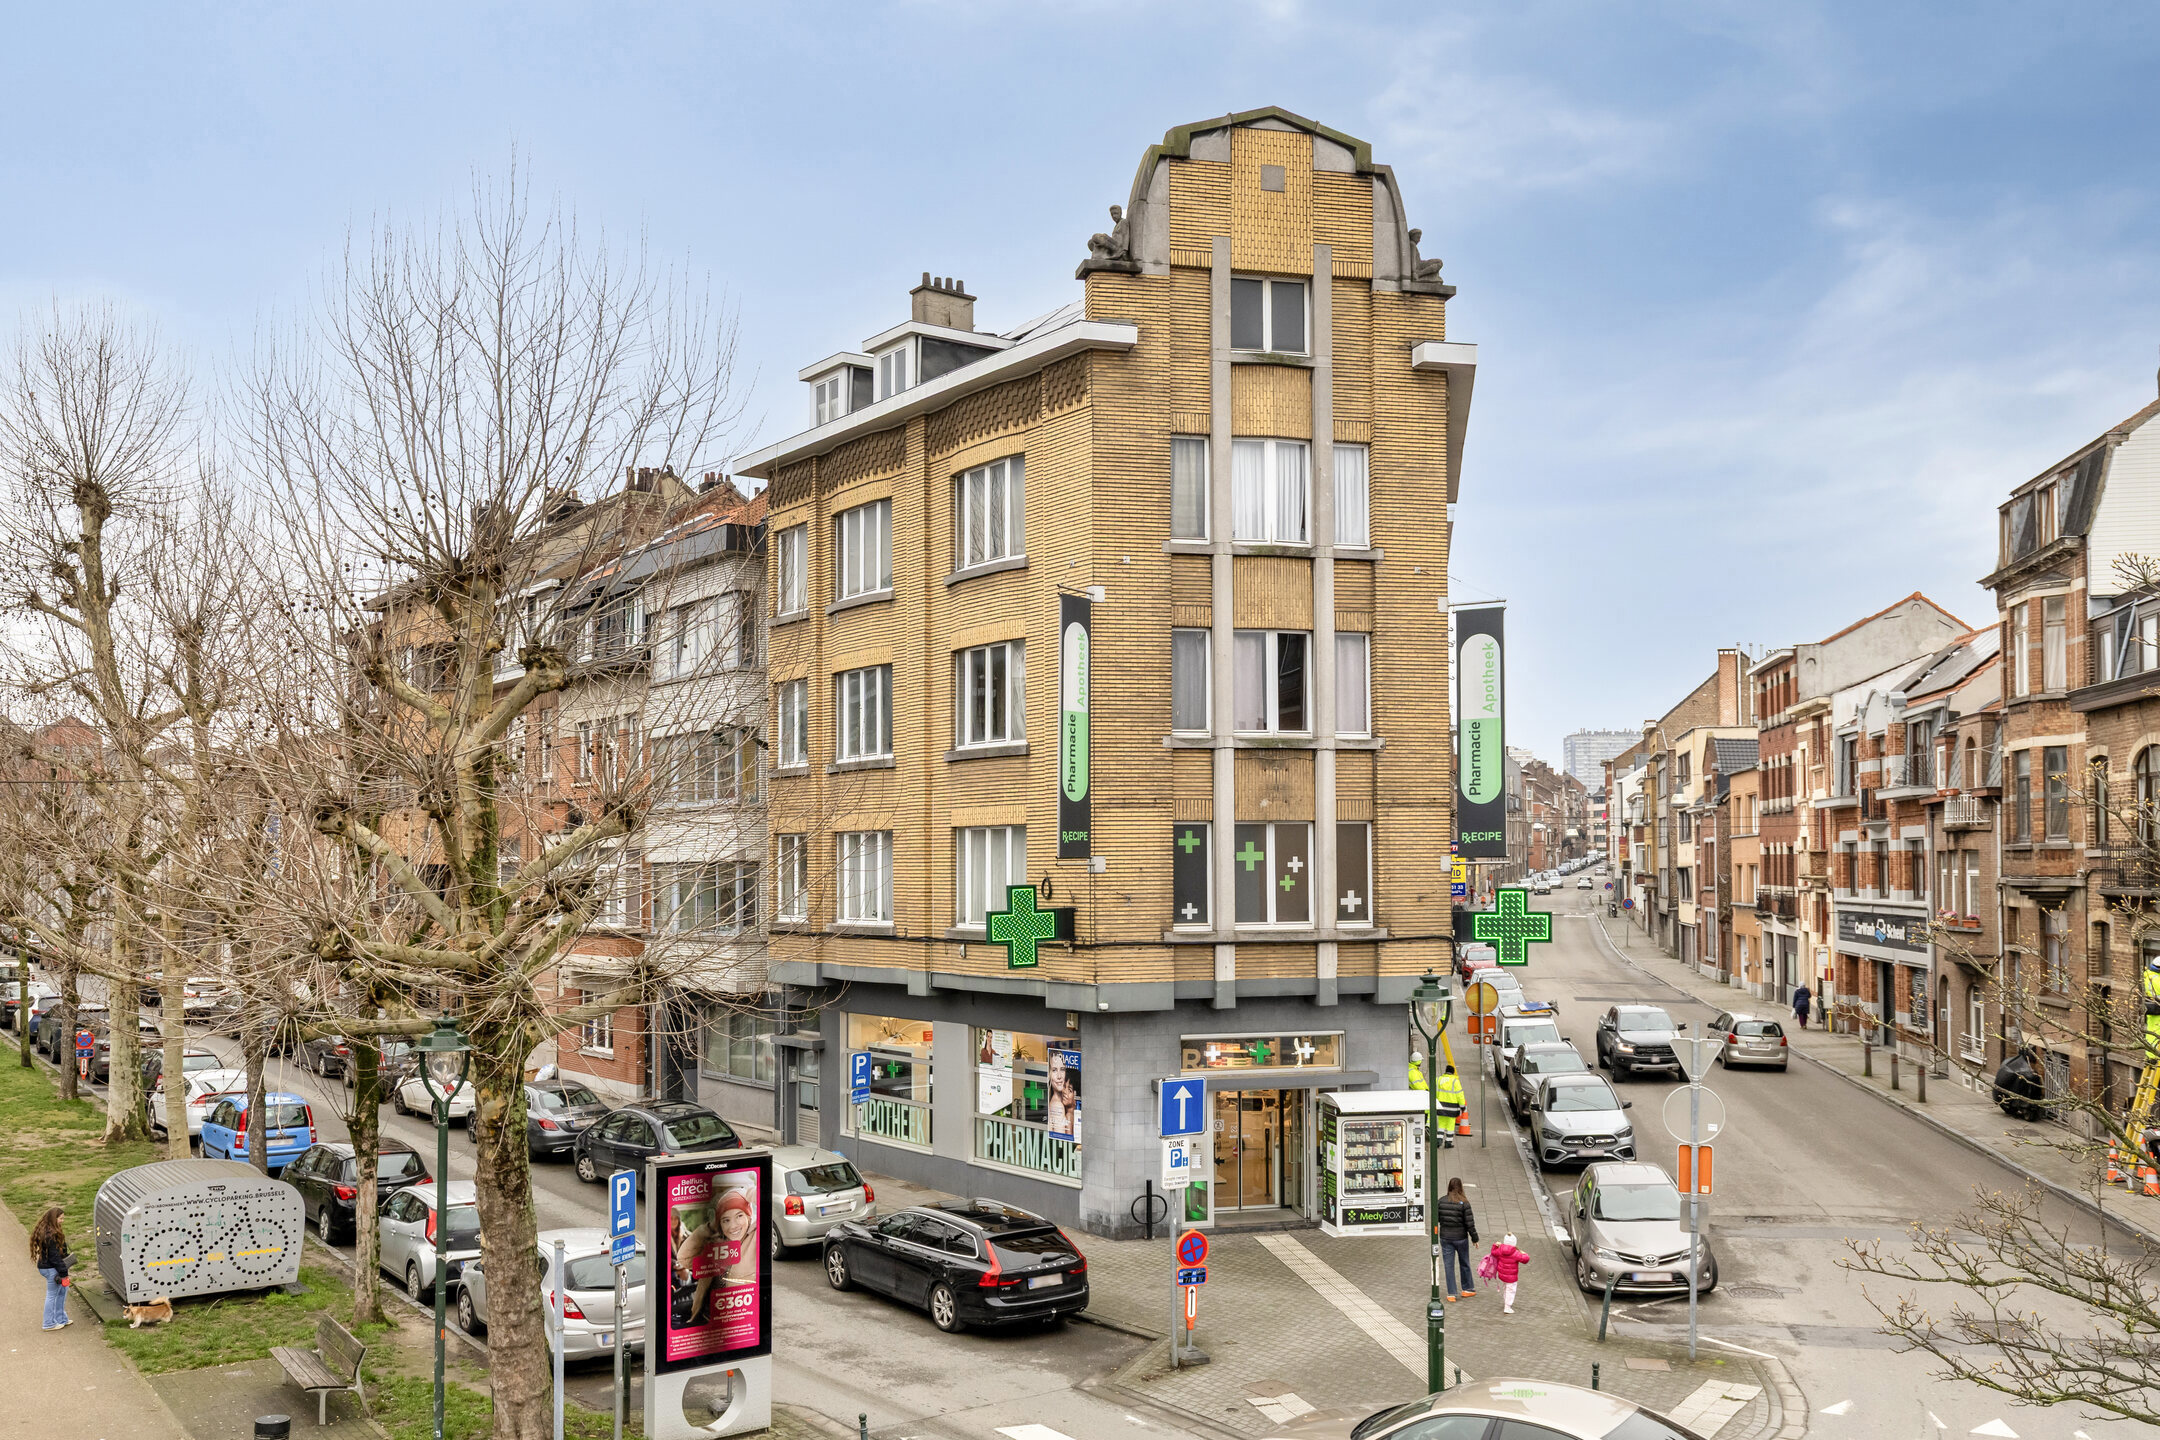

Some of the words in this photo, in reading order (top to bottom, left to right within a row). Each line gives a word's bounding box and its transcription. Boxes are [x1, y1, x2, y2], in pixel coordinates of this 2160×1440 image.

[1077, 632, 1086, 707] Apotheek
[1482, 641, 1495, 713] Apotheek
[1067, 714, 1077, 793] Pharmacie
[1469, 721, 1481, 796] Pharmacie
[855, 1055, 867, 1075] P
[861, 1099, 926, 1145] APOTHEEK
[1168, 1140, 1185, 1148] ZONE
[704, 1162, 728, 1170] JCDecaux
[1171, 1150, 1180, 1166] P
[671, 1182, 709, 1197] direct
[681, 1178, 703, 1186] Belfius
[186, 1190, 286, 1205] WWW.CYCLOPARKING.BRUSSELS
[616, 1176, 630, 1212] P
[1360, 1211, 1402, 1222] MedyBOX
[707, 1245, 739, 1260] -15%
